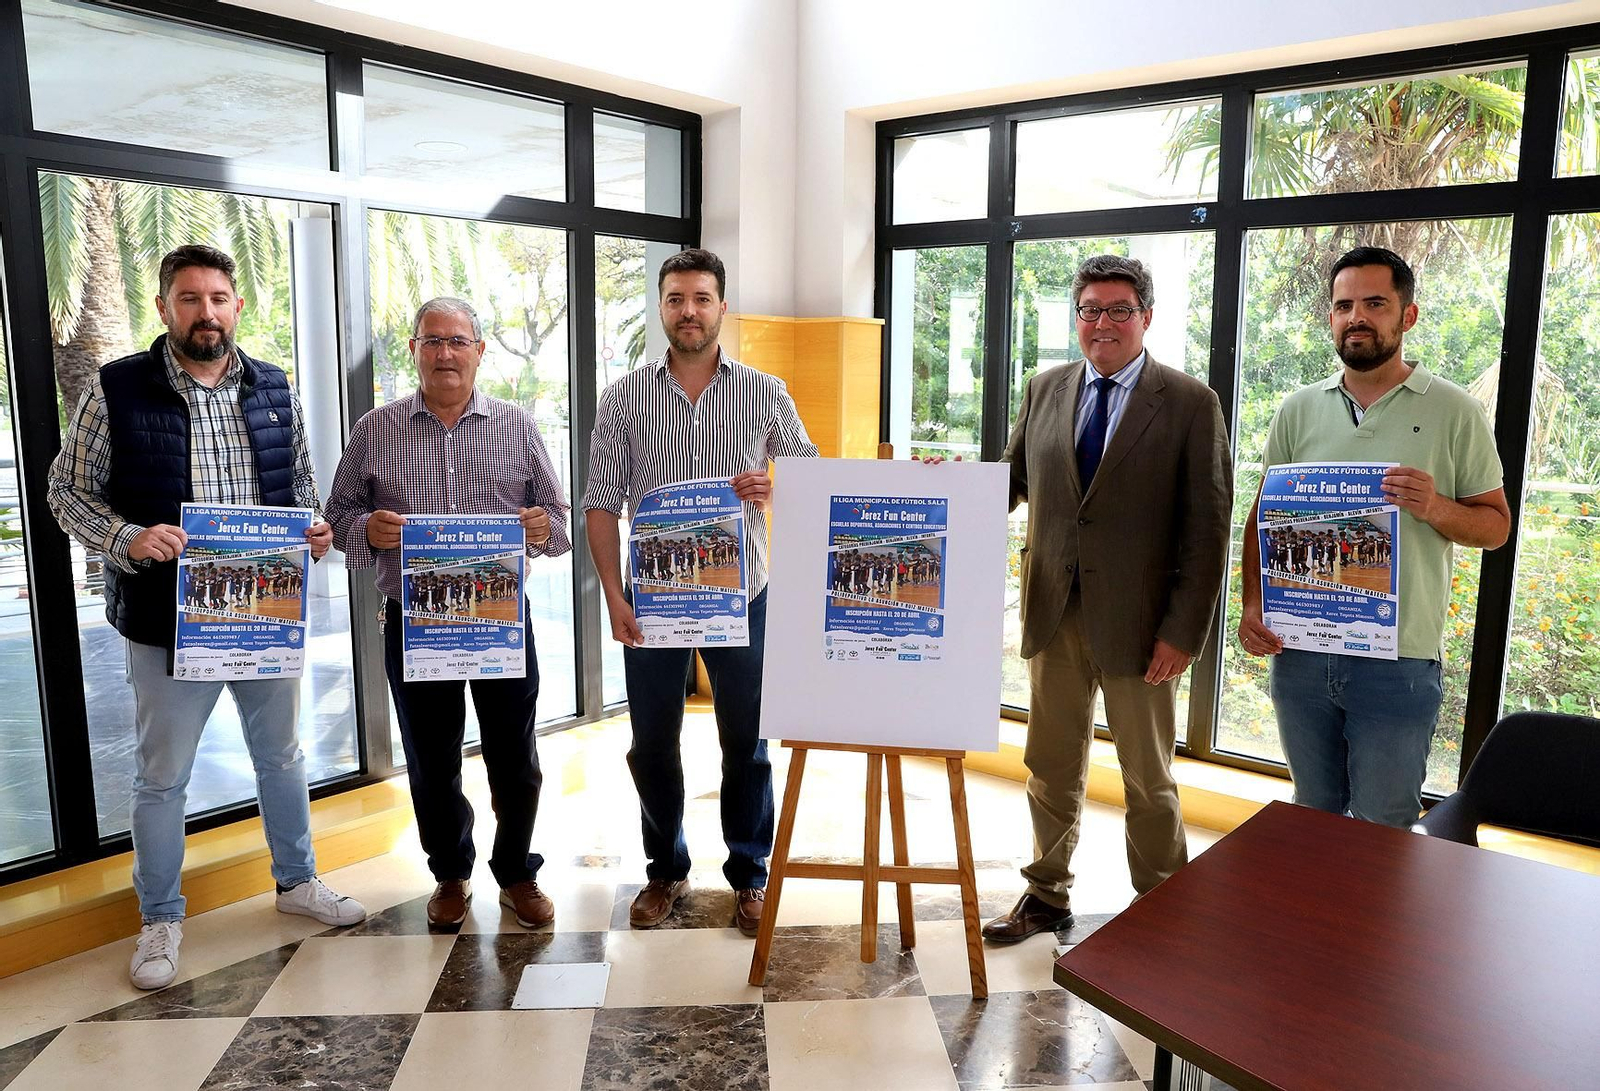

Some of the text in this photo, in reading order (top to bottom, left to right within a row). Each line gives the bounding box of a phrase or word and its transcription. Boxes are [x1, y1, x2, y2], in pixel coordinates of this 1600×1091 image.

[1294, 481, 1370, 494] Jerez Fun Center
[660, 495, 720, 508] Jerez Fun Center
[861, 510, 926, 522] Jerez Fun Center
[218, 522, 288, 534] Jerez Fun Center
[435, 532, 502, 542] Jerez Fun Center
[1267, 570, 1306, 582] POLIDEPORTIVO
[1317, 580, 1342, 589] ASUNCIÓN
[1366, 590, 1387, 599] MATEOS
[831, 591, 866, 601] POLIDEPORTIVO
[876, 598, 899, 606] ASUNCIÓN
[1284, 590, 1313, 599] INSCRIPCIÓN
[184, 607, 224, 616] POLIDEPORTIVO
[409, 611, 446, 619] POLIDEPORTIVO
